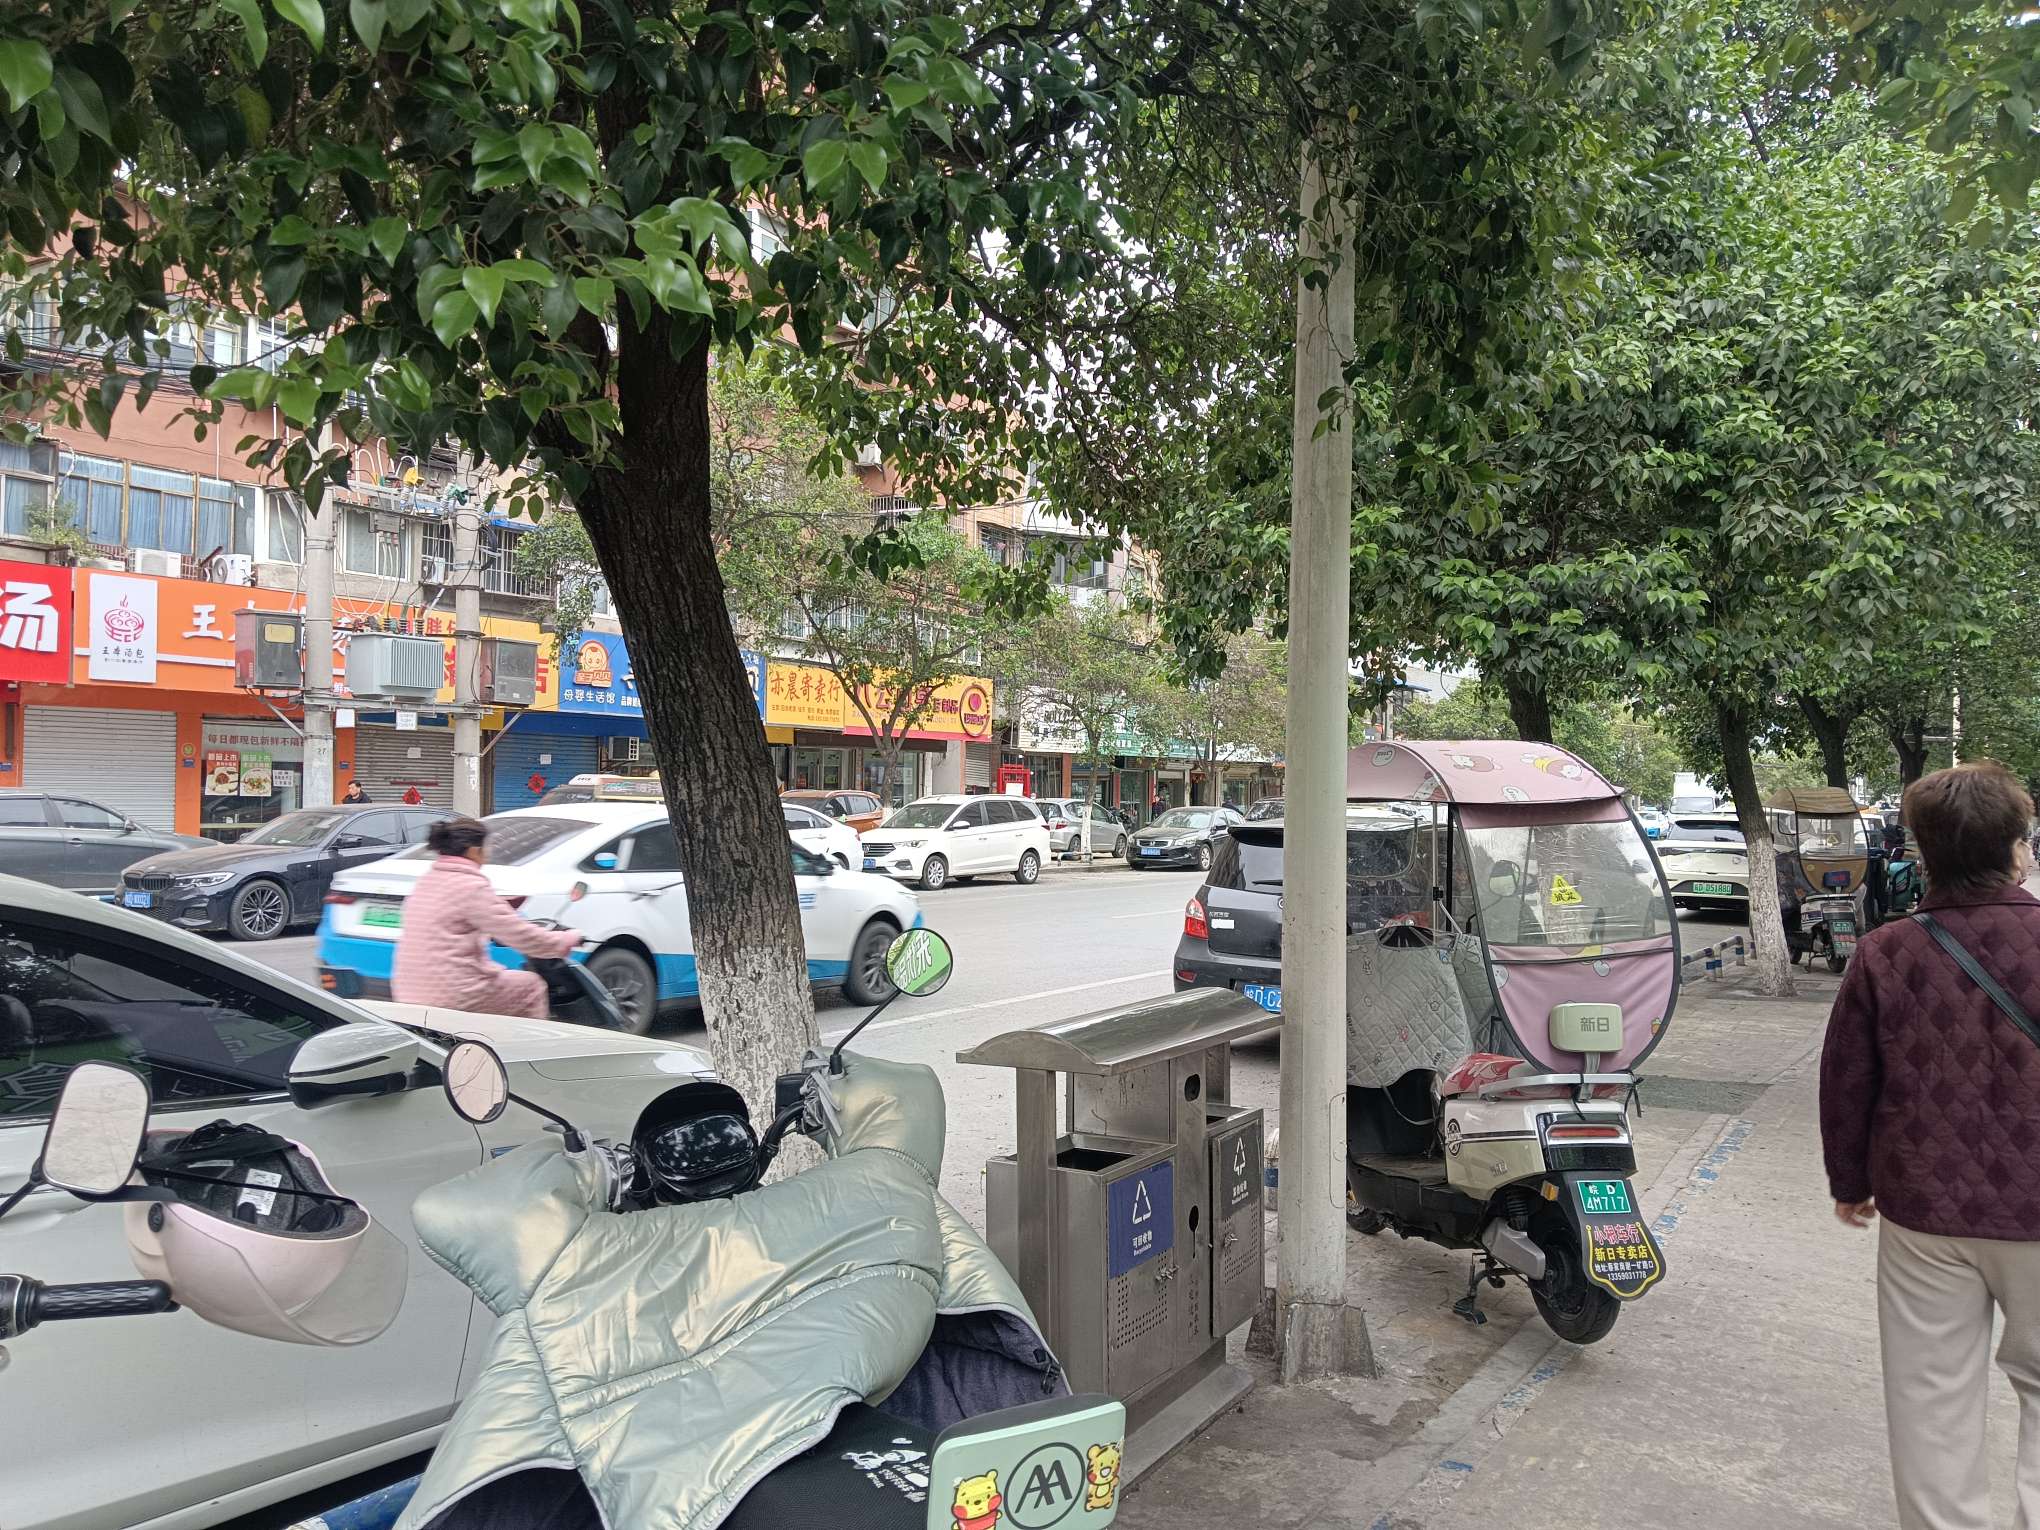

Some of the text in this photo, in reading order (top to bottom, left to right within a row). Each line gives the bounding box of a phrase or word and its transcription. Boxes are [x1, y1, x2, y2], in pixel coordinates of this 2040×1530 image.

[563, 688, 616, 704] 母婴生活馆
[1580, 1017, 1610, 1033] 新日
[1605, 1184, 1616, 1195] D
[1586, 1196, 1625, 1210] 4M717
[1594, 1244, 1649, 1262] 新日专卖店
